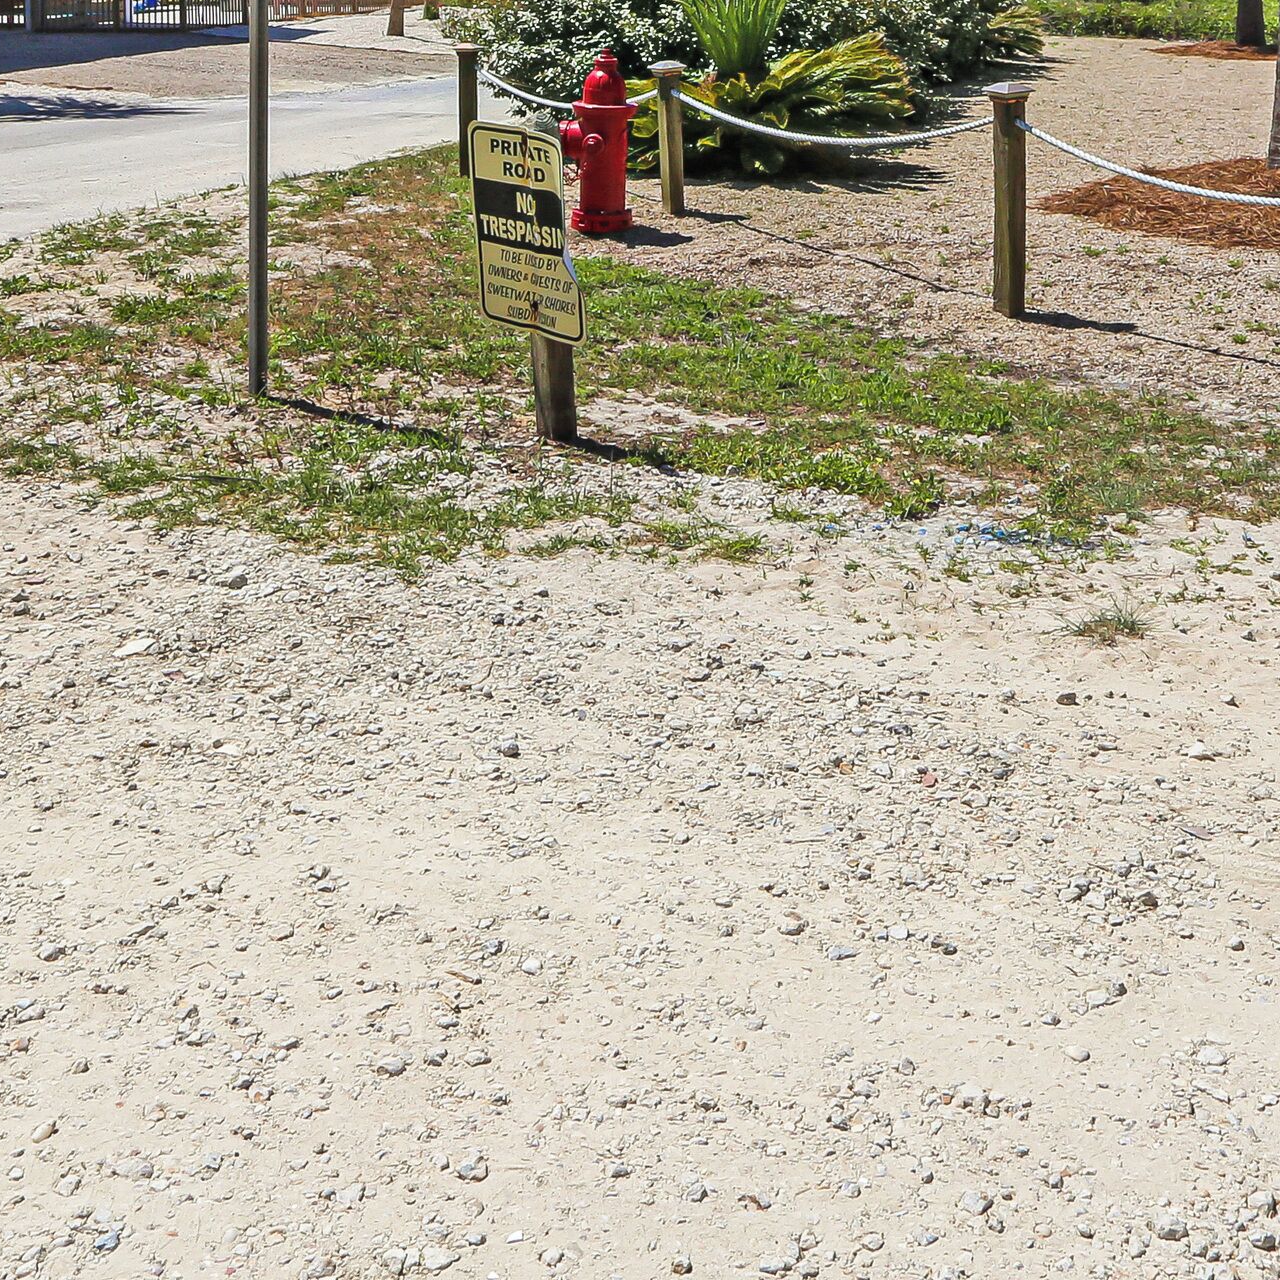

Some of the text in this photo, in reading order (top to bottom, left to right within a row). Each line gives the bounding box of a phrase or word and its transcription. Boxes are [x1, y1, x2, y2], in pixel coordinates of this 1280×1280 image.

[489, 138, 552, 166] PRIVATE
[502, 161, 546, 183] ROAD
[515, 191, 537, 216] NO
[479, 213, 564, 249] TRESPASSIN
[500, 249, 560, 272] TO BE USED BY
[487, 263, 523, 283] OWNERS
[523, 273, 529, 281] &
[562, 280, 574, 295] OF
[544, 296, 576, 316] SHORES
